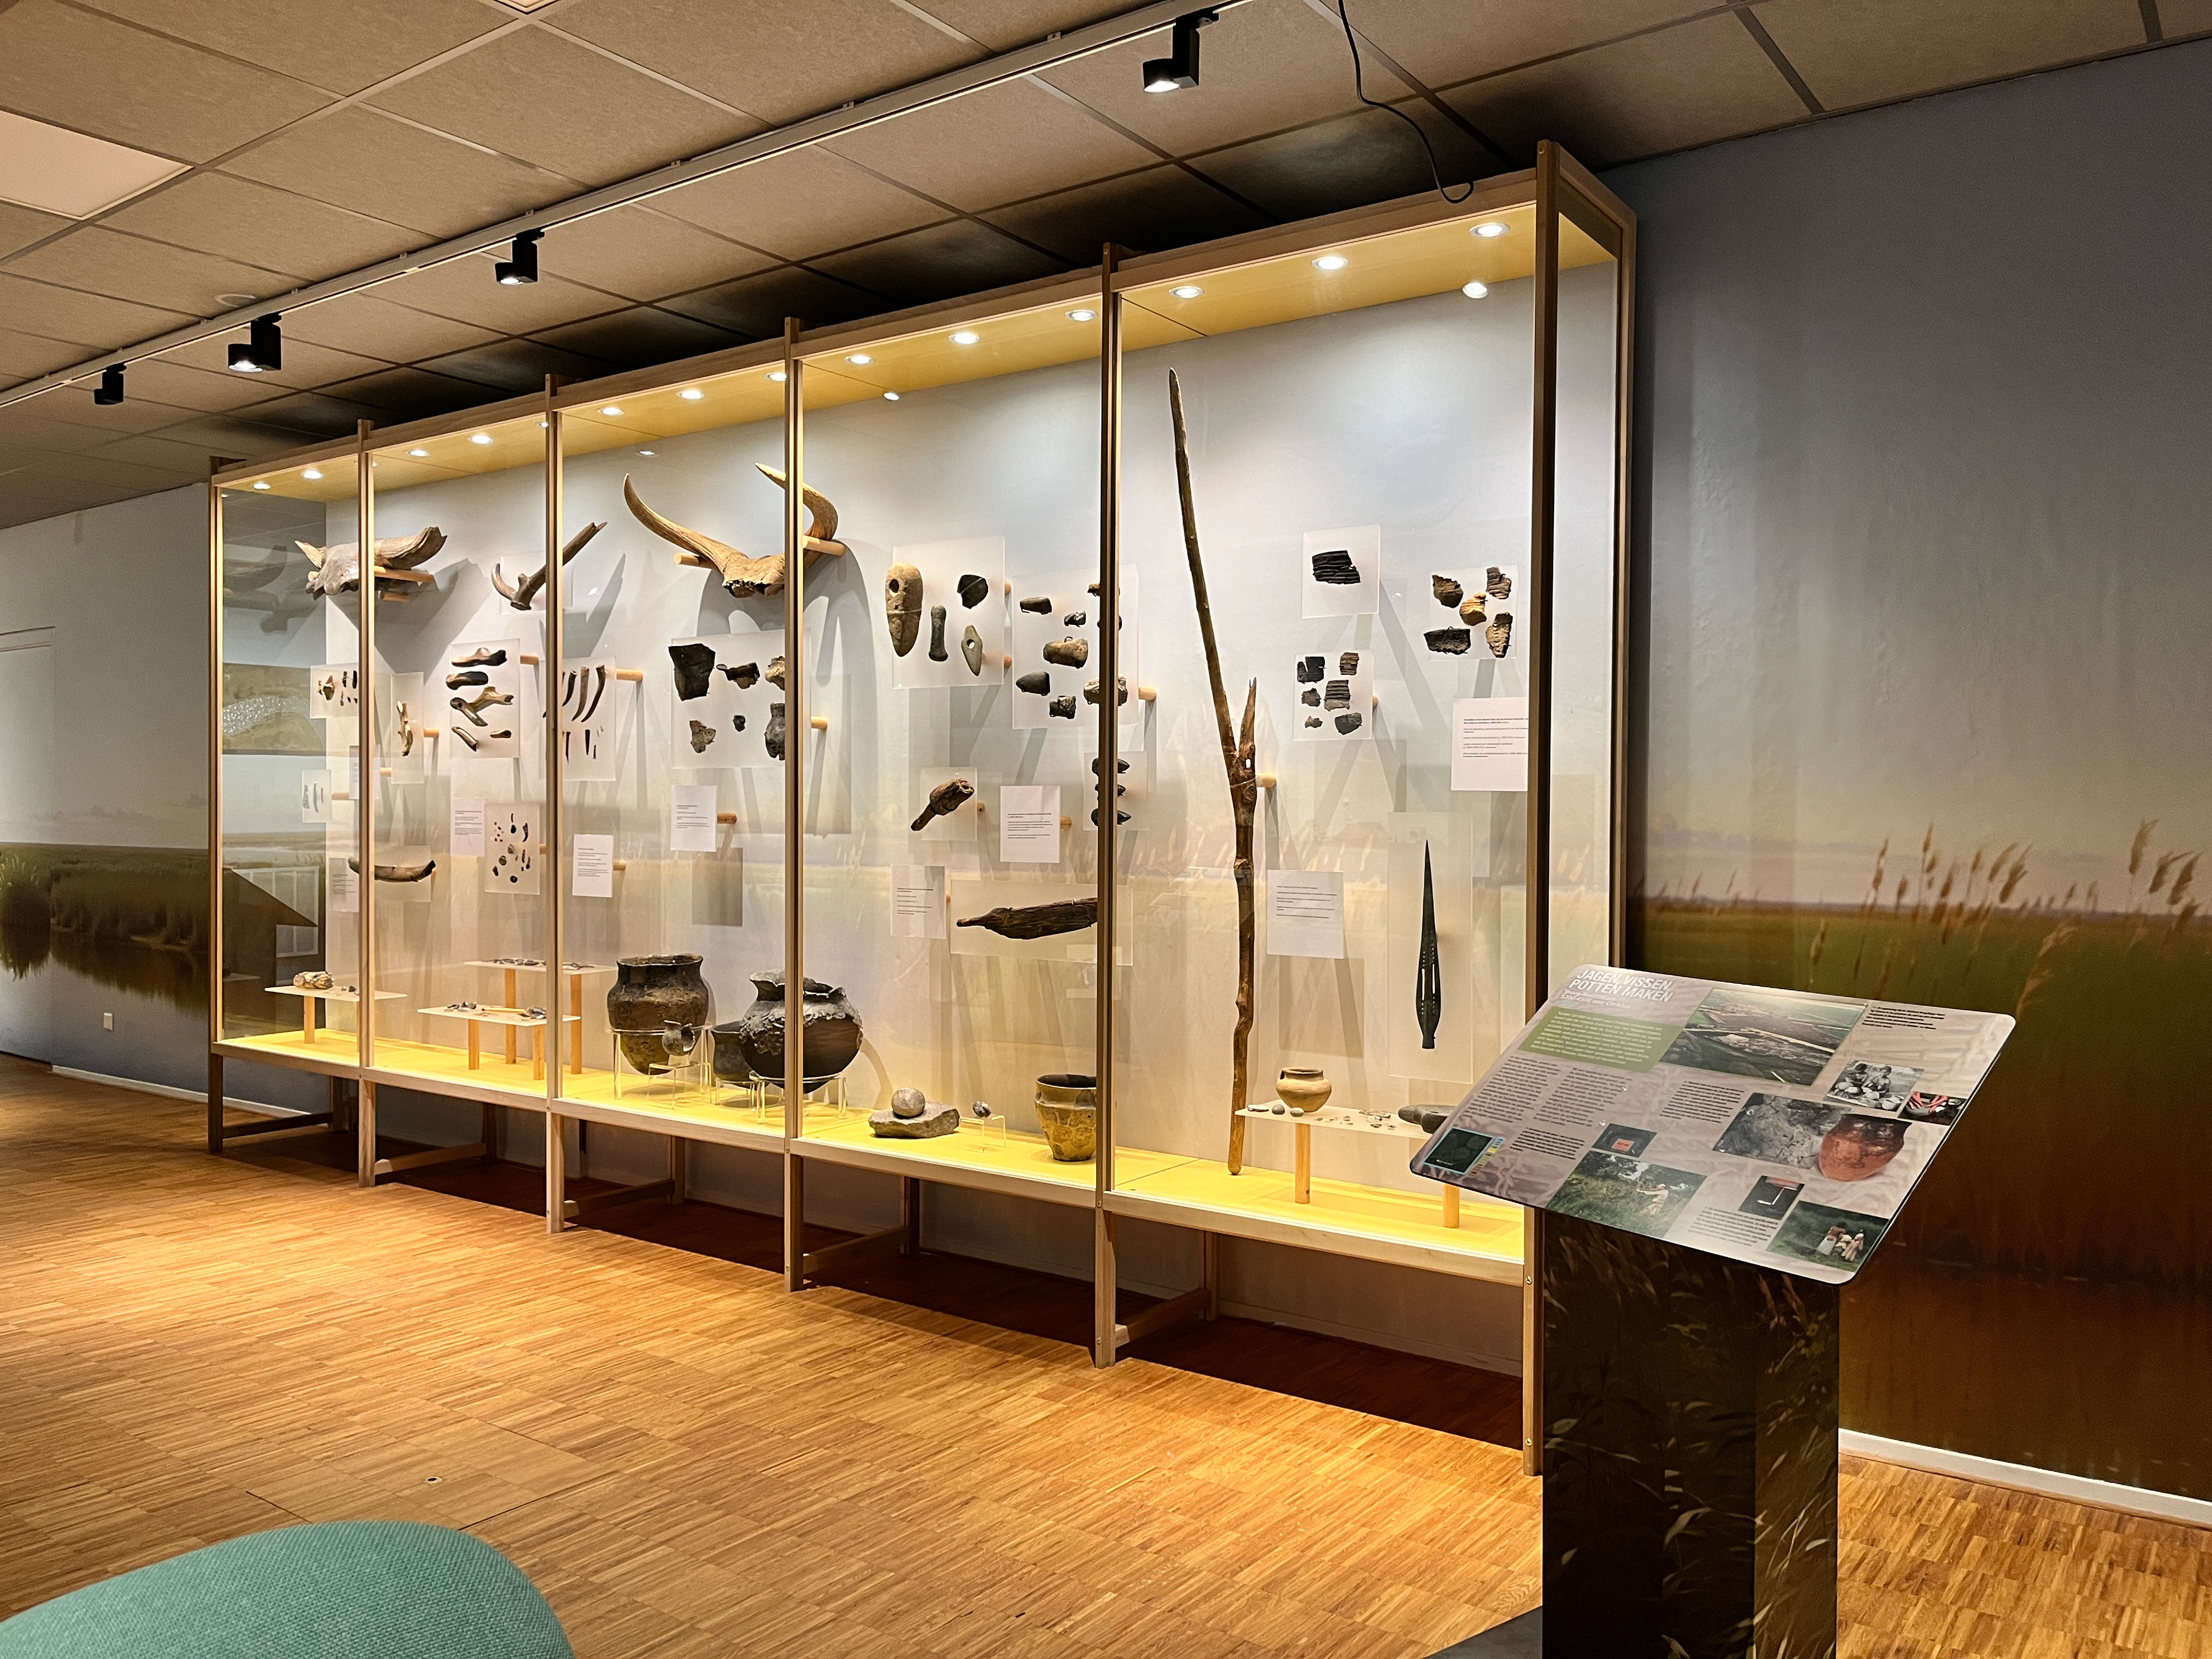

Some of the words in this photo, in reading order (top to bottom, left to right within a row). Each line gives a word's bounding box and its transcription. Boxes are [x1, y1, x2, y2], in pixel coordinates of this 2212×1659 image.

[1569, 979, 1622, 995] POTTEN
[1622, 986, 1673, 1002] MAKEN
[1577, 970, 1622, 984] JAGEN,
[1623, 975, 1672, 991] VISSEN,
